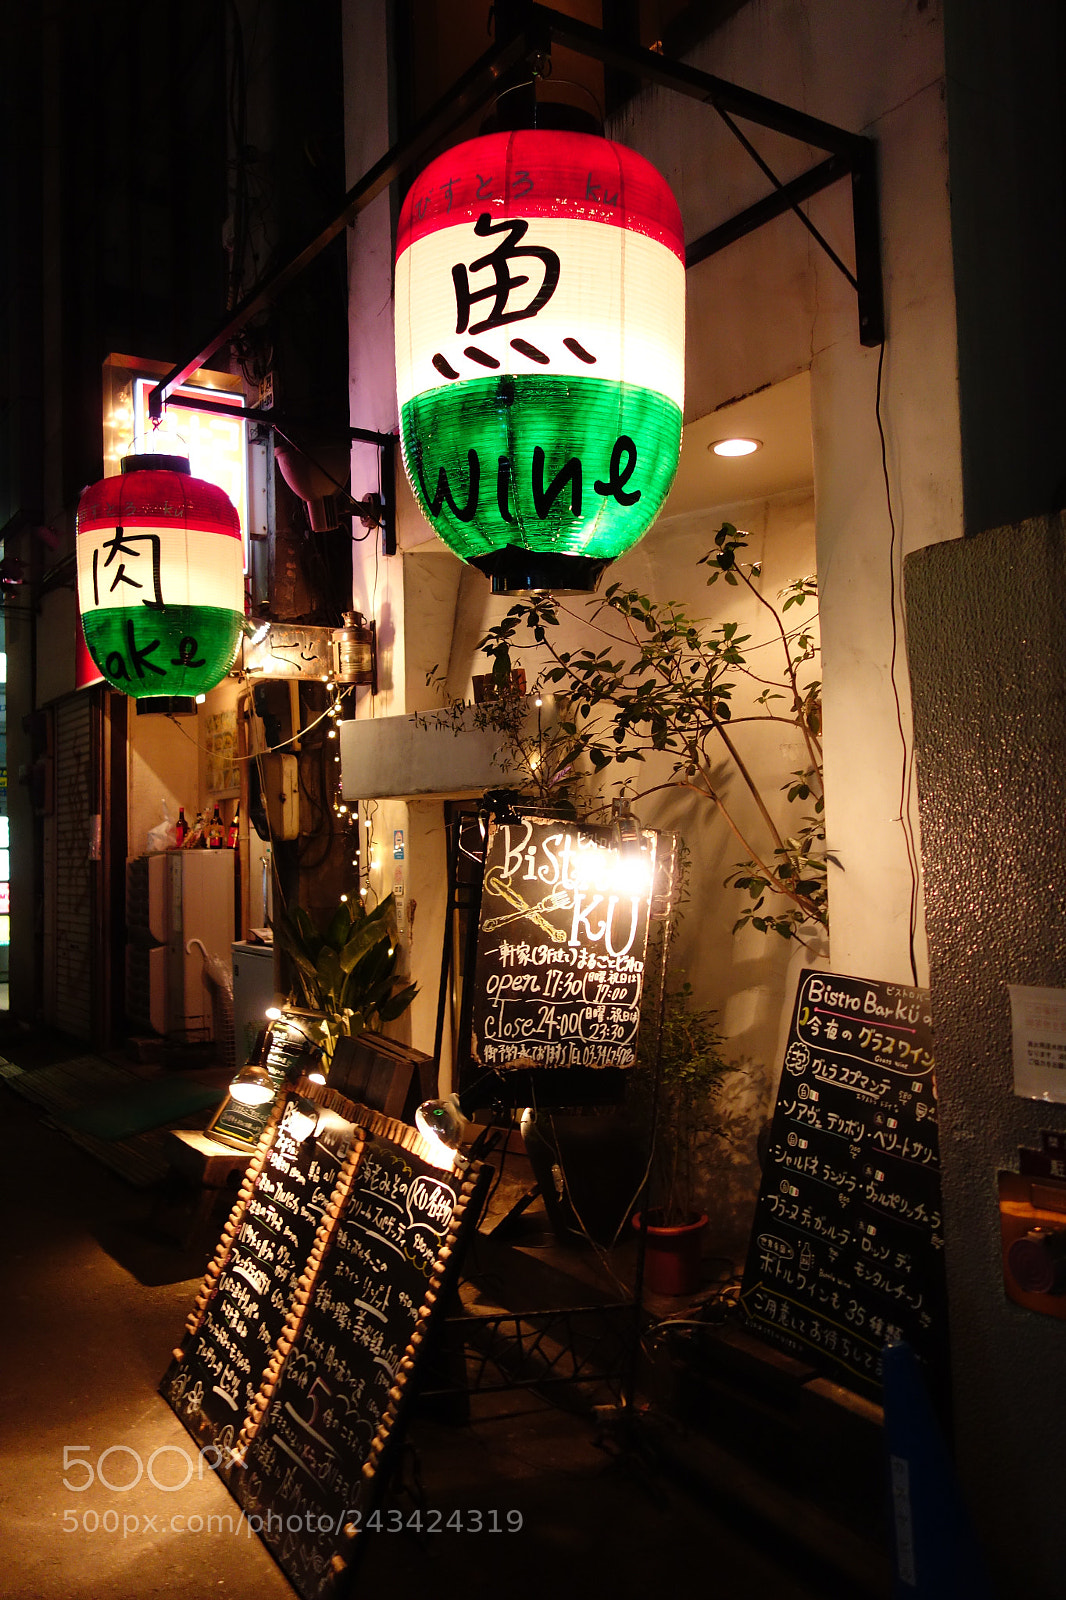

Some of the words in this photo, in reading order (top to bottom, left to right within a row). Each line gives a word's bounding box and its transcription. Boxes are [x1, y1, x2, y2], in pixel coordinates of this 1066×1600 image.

[432, 213, 597, 380] 魚
[93, 527, 166, 612] 肉
[92, 619, 206, 682] ake
[542, 970, 583, 998] 17:30
[593, 984, 628, 1004] 17:00
[808, 980, 861, 1011] Bistro
[863, 990, 895, 1018] Bar
[537, 1006, 579, 1040] 24:00
[589, 1024, 625, 1041] 23:30
